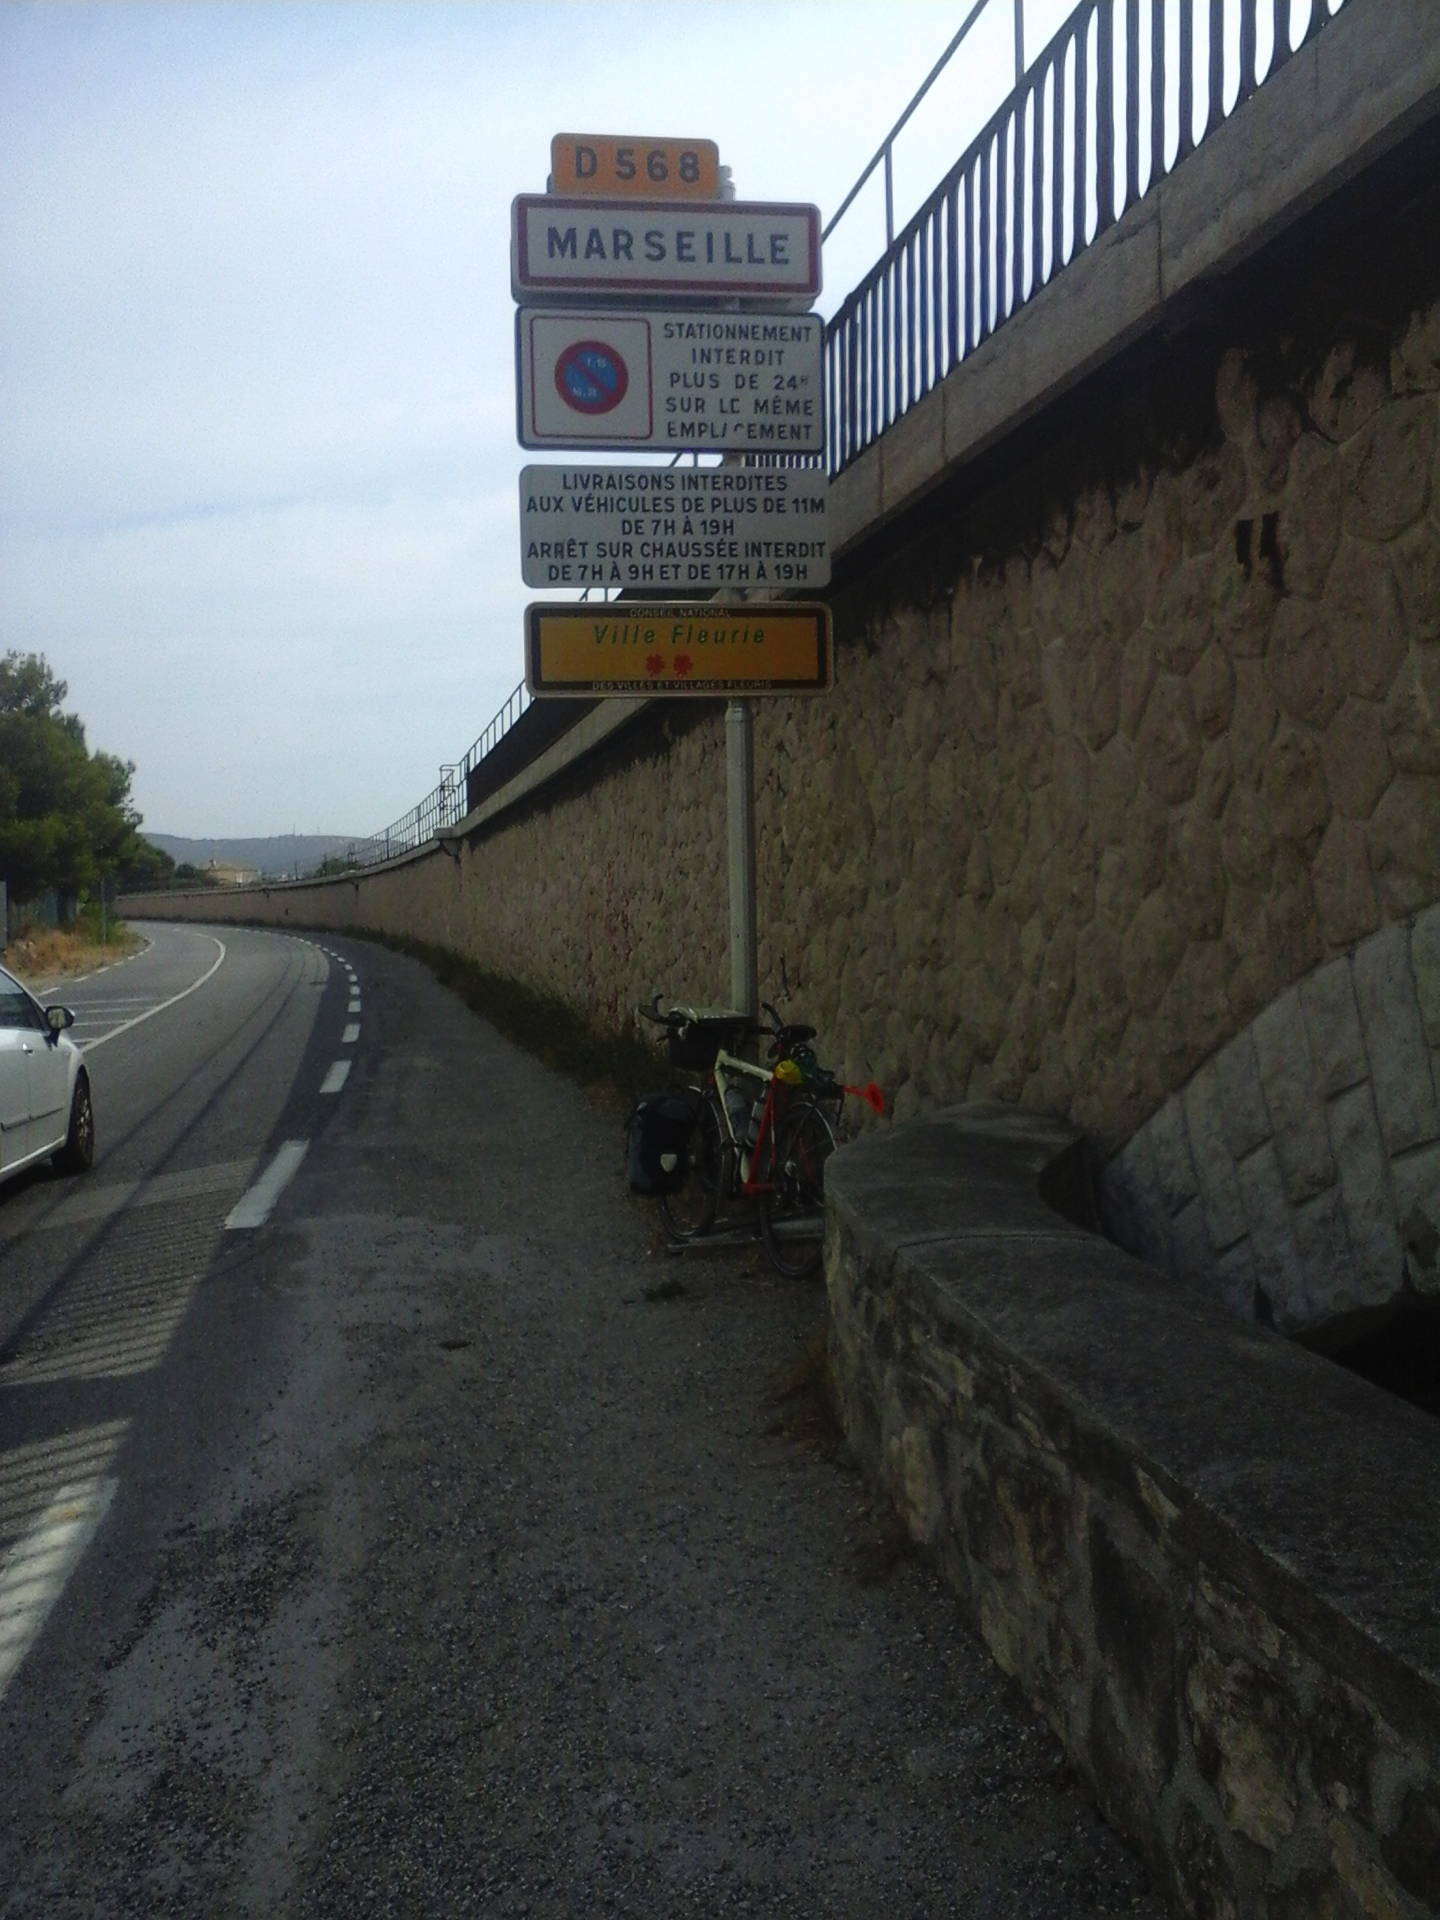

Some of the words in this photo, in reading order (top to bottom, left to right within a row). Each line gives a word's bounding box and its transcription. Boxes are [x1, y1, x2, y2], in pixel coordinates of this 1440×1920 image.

[575, 146, 598, 178] D
[615, 148, 701, 183] 568
[547, 226, 790, 265] MARSEILLE
[664, 323, 813, 343] STATIONNEMENT
[691, 348, 785, 366] INTERDIT
[670, 372, 720, 389] PLUS
[735, 374, 759, 390] DE
[665, 396, 706, 414] SUR
[562, 474, 675, 492] LIVRAISONS
[681, 474, 788, 492] INTERDITES
[526, 496, 564, 513] AUX
[571, 495, 675, 513] VÉHICULES
[682, 497, 705, 513] DE
[712, 497, 758, 514] PLUS
[763, 498, 785, 514] DE
[792, 498, 825, 514] 11M
[621, 519, 644, 536] DE
[651, 519, 675, 536] 7H
[682, 515, 694, 535] À
[700, 519, 735, 535] 19H
[528, 538, 589, 559] ARRÊT
[597, 541, 634, 558] SUR
[640, 538, 739, 558] CHAUSSÉE
[744, 541, 826, 557] INTERDIT
[548, 564, 571, 581] DE
[579, 564, 603, 581] 7H
[609, 561, 621, 581] À
[628, 564, 654, 580] 9H
[660, 563, 681, 580] ET
[688, 563, 711, 580] DE
[716, 563, 749, 580] 17H
[756, 559, 767, 580] À
[774, 563, 808, 580] 19H
[592, 624, 656, 645] Ville
[671, 623, 766, 644] Fleurie
